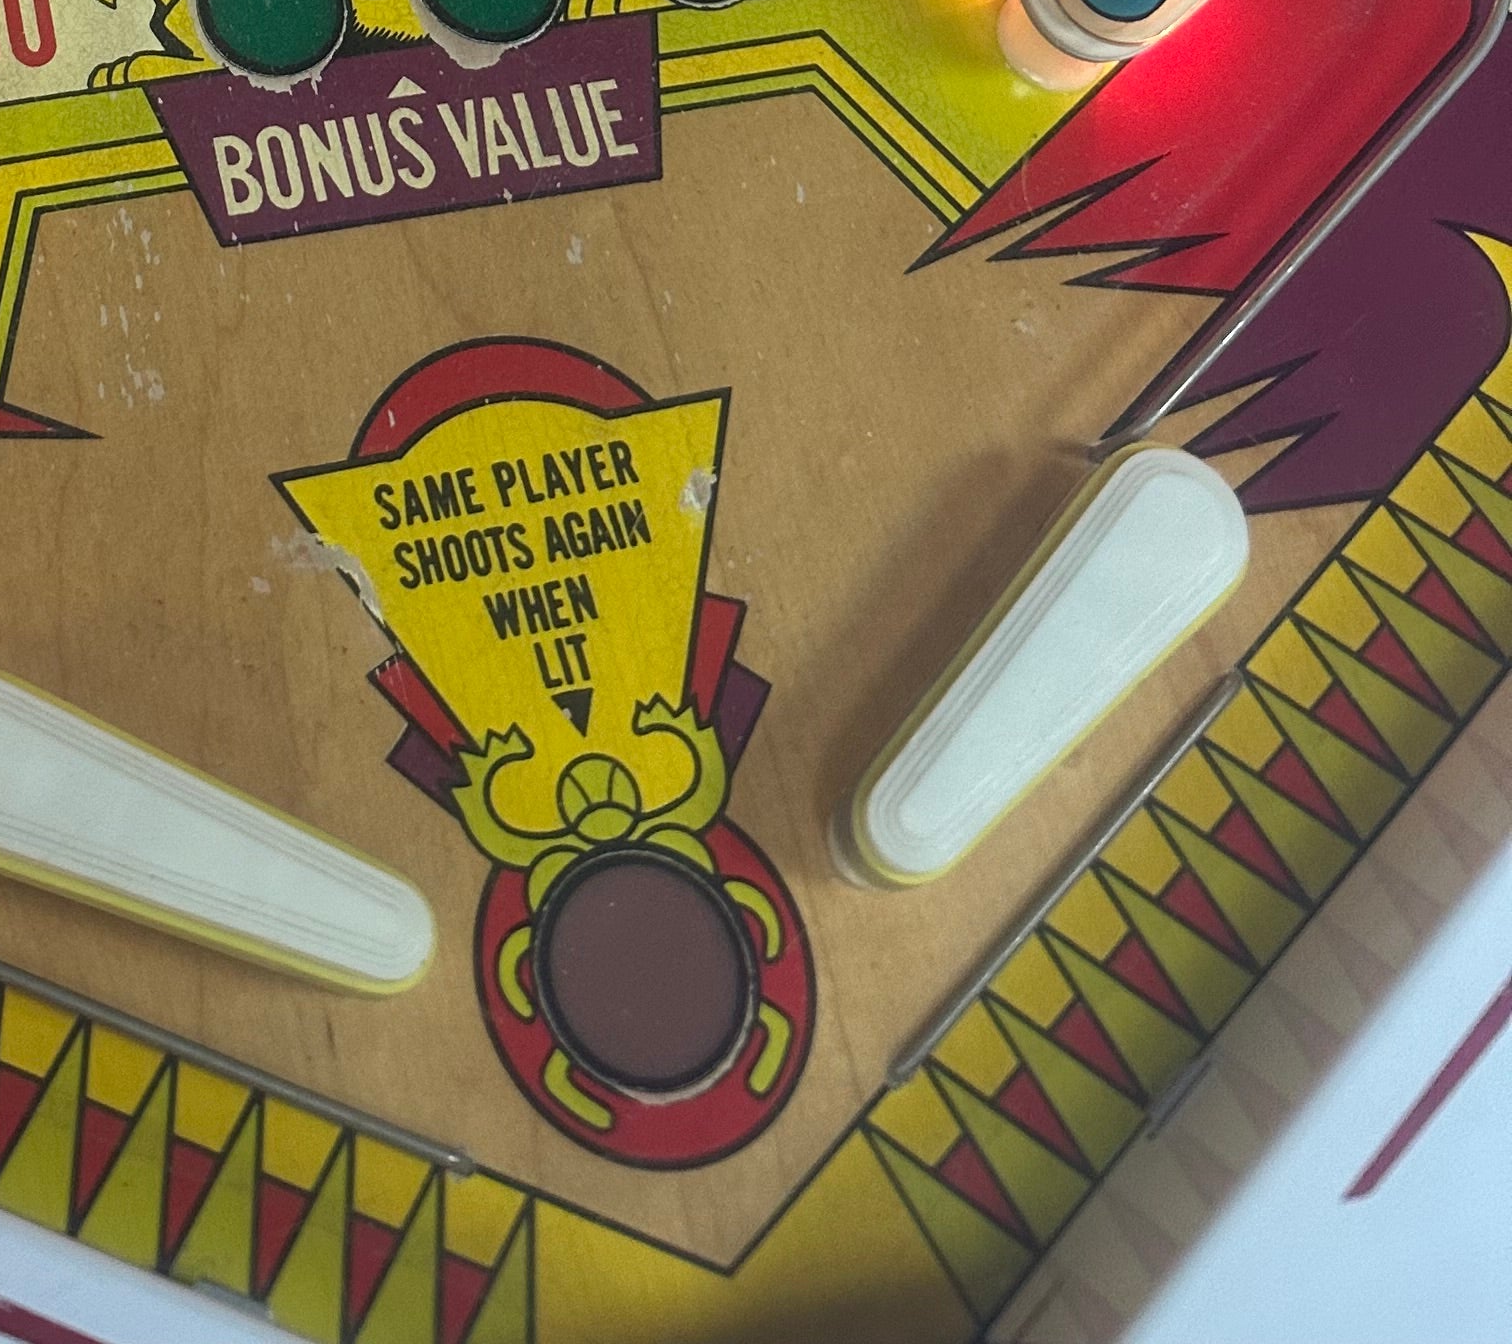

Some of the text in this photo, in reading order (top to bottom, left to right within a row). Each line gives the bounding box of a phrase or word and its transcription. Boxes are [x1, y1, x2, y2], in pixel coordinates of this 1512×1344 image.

[212, 78, 639, 216] BONUS VALUE
[373, 440, 640, 530] SAME PLAYER
[393, 498, 652, 590] SHOOTS AGAIN
[482, 574, 599, 641] WHEN
[533, 633, 592, 689] LIT
